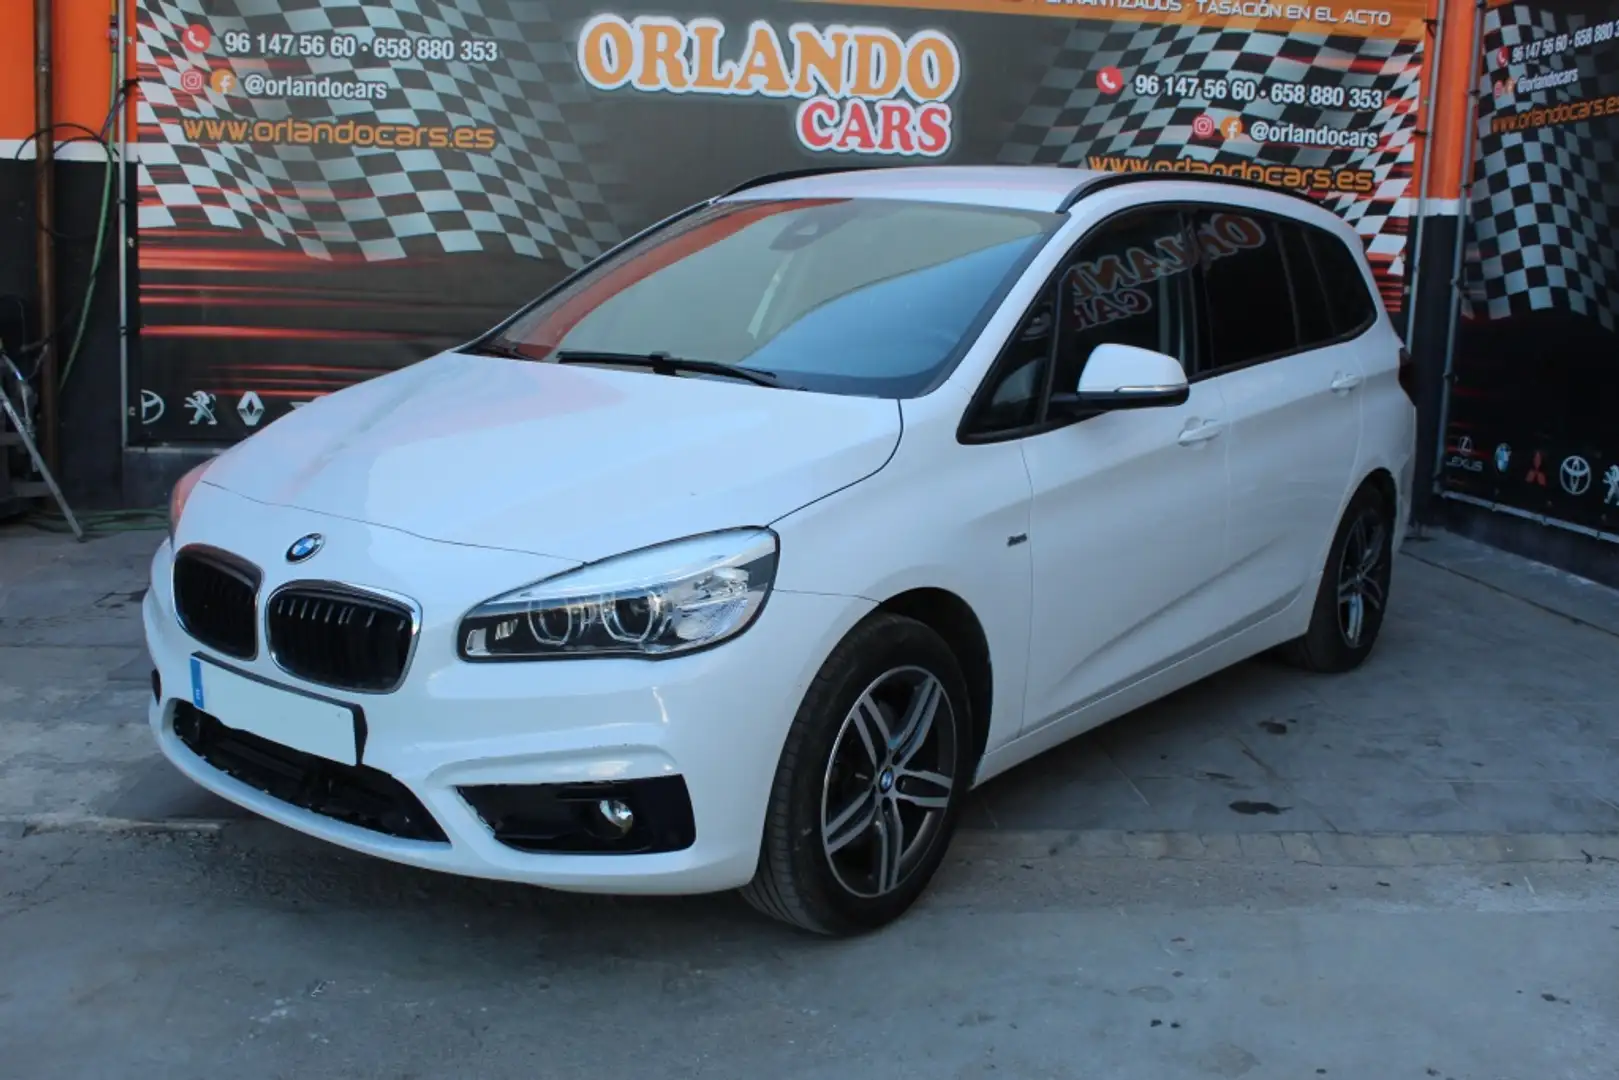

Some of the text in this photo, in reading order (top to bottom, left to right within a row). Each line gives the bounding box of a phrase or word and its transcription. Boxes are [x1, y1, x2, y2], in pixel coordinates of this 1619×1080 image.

[1196, 0, 1282, 18] TASACIÓN
[1287, 5, 1311, 20] EN
[1315, 7, 1338, 22] EL
[1343, 10, 1391, 26] ACTO
[224, 31, 498, 62] 96 147 56 60 658 880 353
[580, 17, 958, 101] ORLANDO
[244, 73, 388, 99] @orlandocars
[1135, 74, 1383, 109] 96 147 56 60 658 880 353
[182, 117, 496, 149] www.orlandocars.es
[799, 99, 949, 154] CARS
[1250, 120, 1378, 148] @orlandocars
[1088, 155, 1373, 191] wwworlandocars.es
